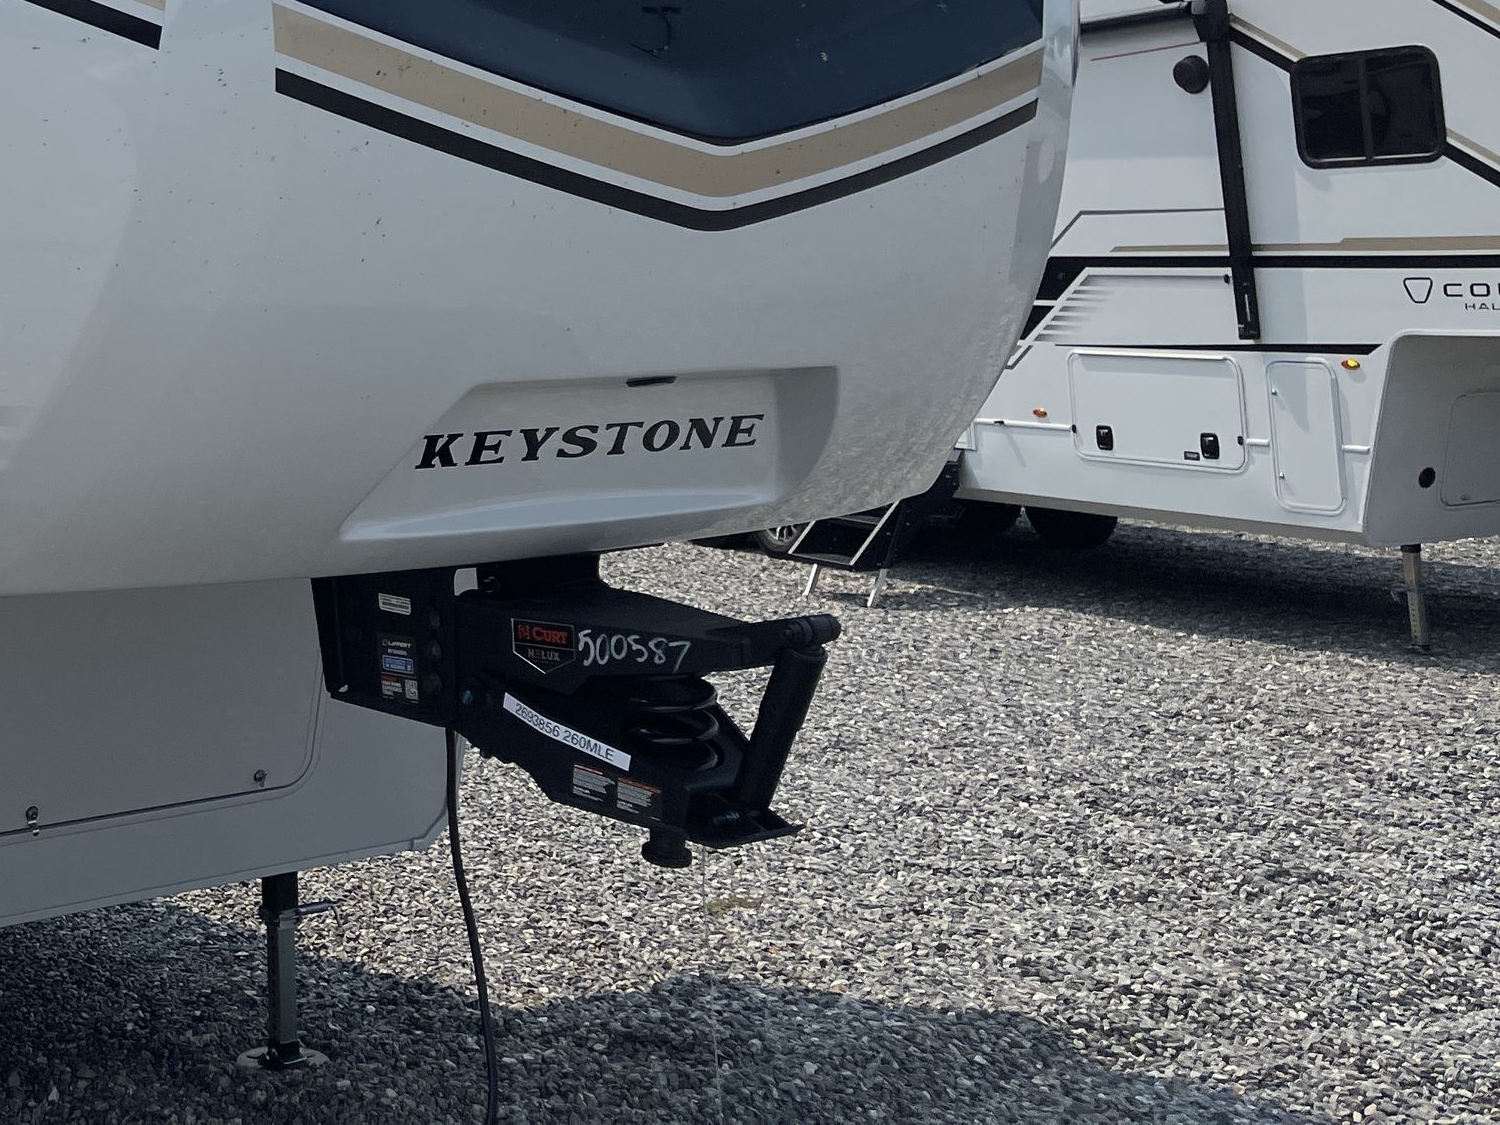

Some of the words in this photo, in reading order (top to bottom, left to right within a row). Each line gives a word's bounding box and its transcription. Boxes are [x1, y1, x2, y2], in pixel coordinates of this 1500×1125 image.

[1443, 283, 1500, 297] CO
[415, 414, 765, 470] KEYSTONE
[532, 626, 568, 644] CURT
[527, 647, 561, 662] HELUX
[578, 629, 692, 674] 500587
[515, 702, 561, 738] 2693856
[562, 730, 616, 763] 260MLE
